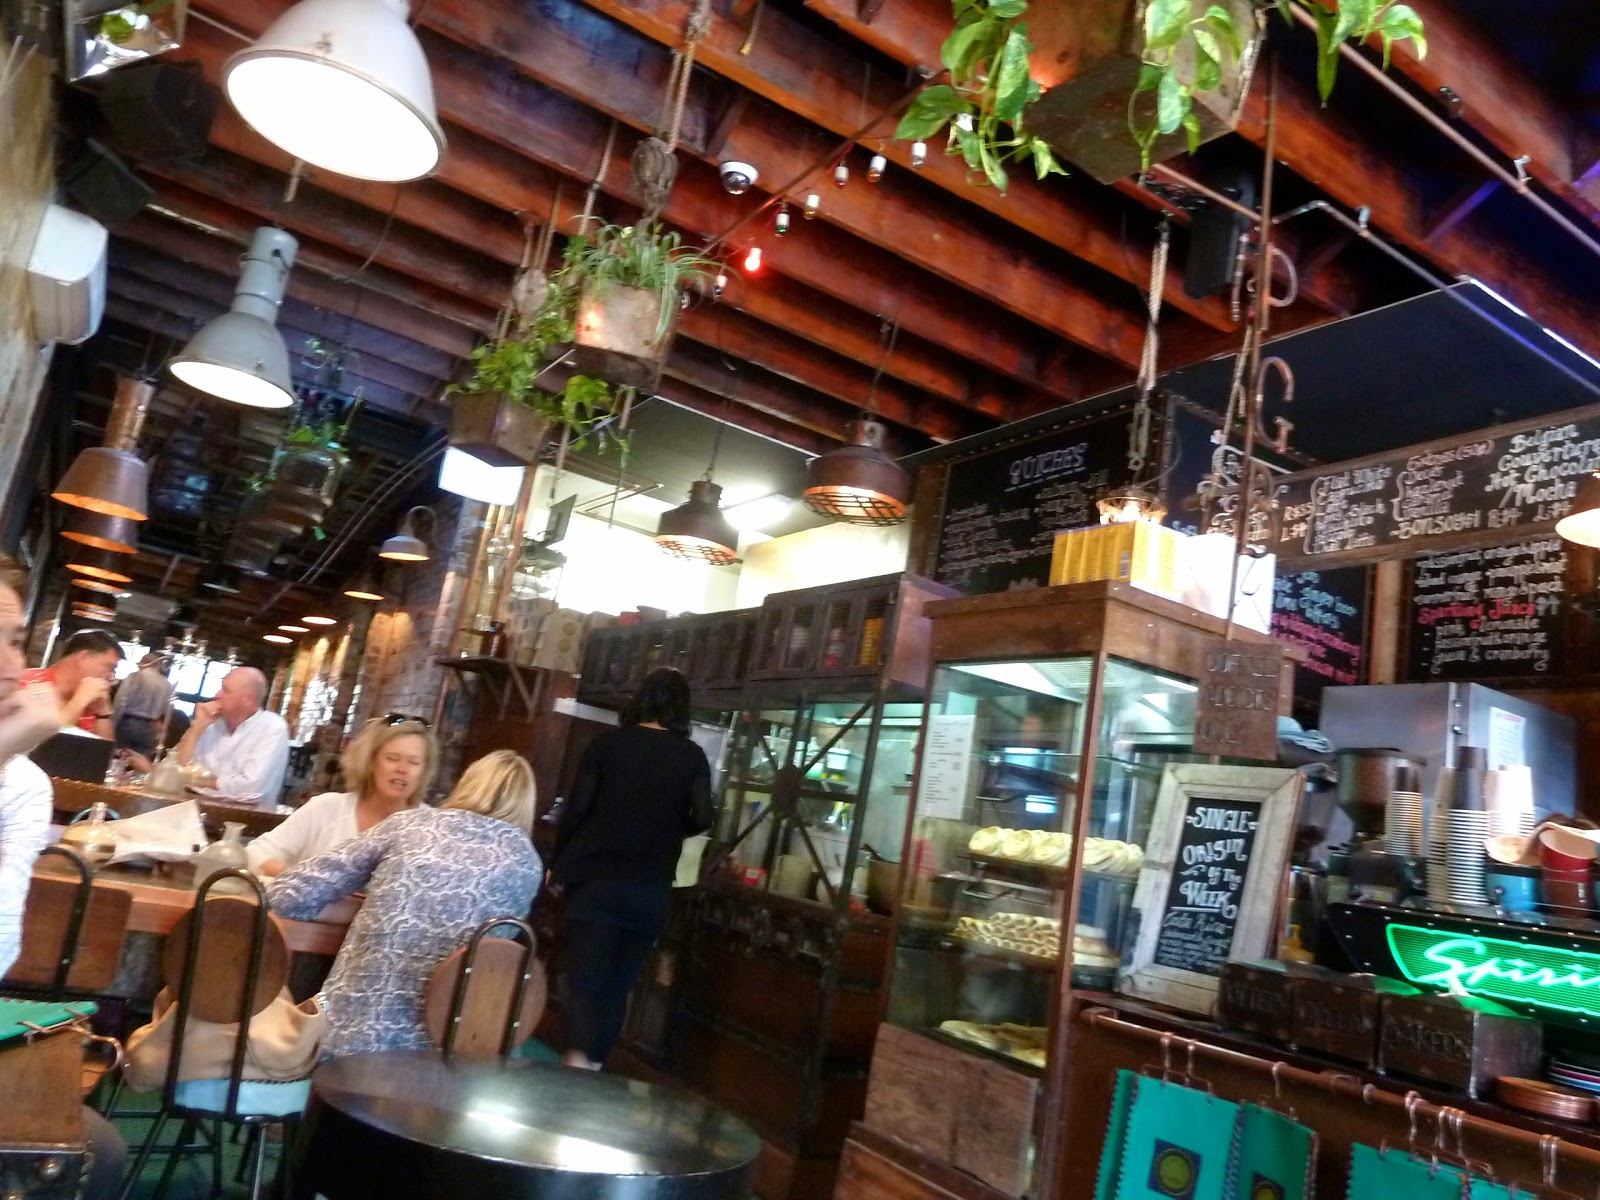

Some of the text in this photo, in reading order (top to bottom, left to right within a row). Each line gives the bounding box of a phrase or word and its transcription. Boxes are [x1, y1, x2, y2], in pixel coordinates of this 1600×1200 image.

[1509, 424, 1579, 454] Belgian
[1009, 443, 1089, 485] QUICHES
[1484, 470, 1521, 492] Hot
[1195, 806, 1254, 833] SINGLE
[1412, 938, 1600, 998] Spiri
